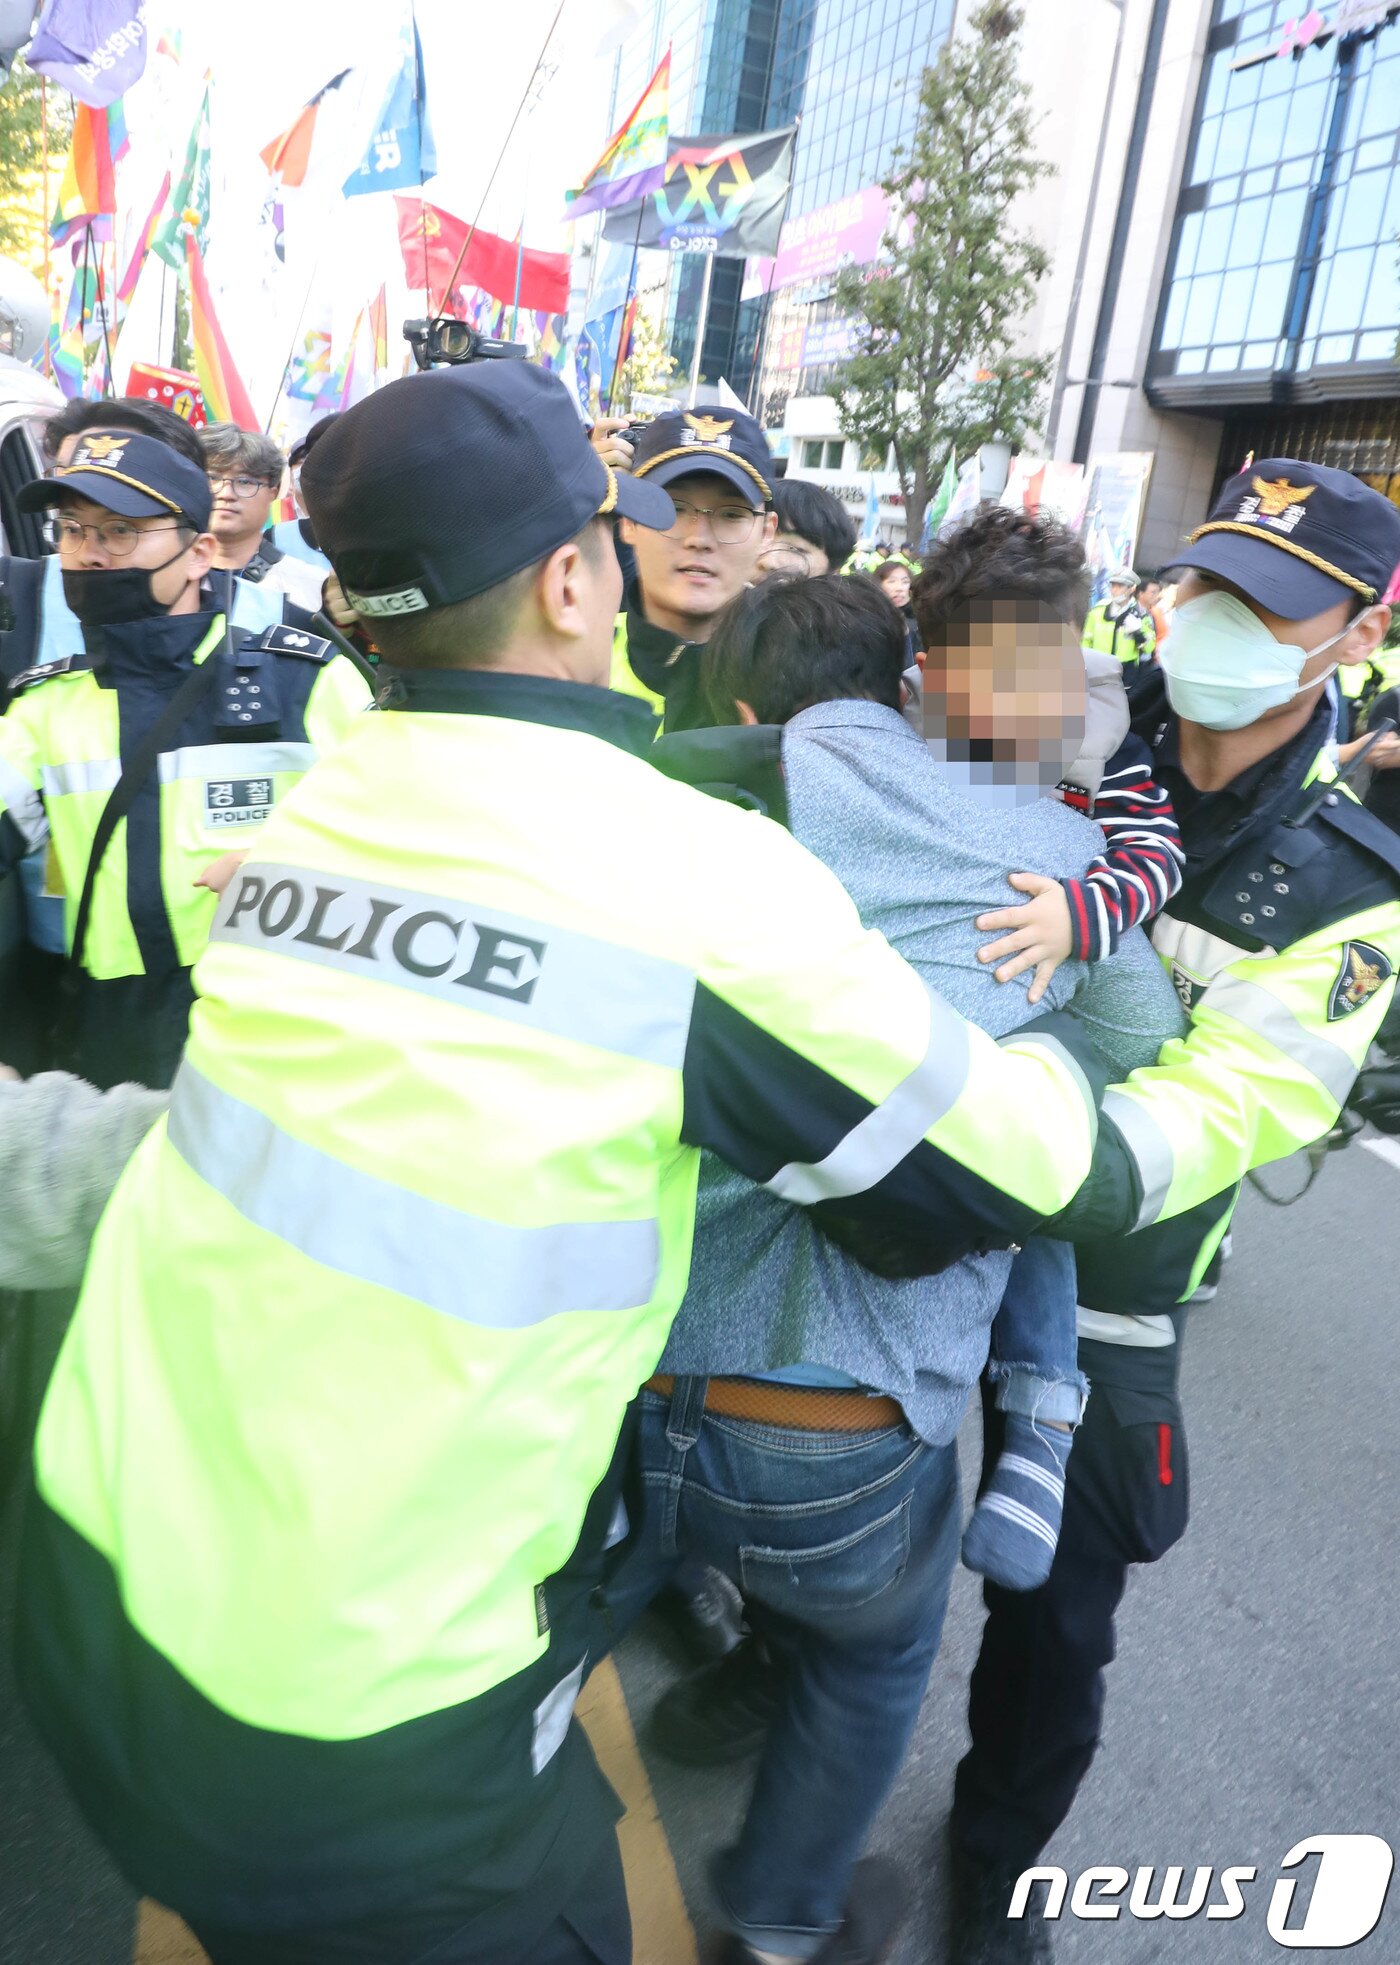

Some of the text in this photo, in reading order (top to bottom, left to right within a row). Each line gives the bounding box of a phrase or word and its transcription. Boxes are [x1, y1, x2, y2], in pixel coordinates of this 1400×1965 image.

[208, 781, 270, 807] 경찰
[212, 809, 271, 823] POLICE
[224, 875, 549, 1005] POLICE
